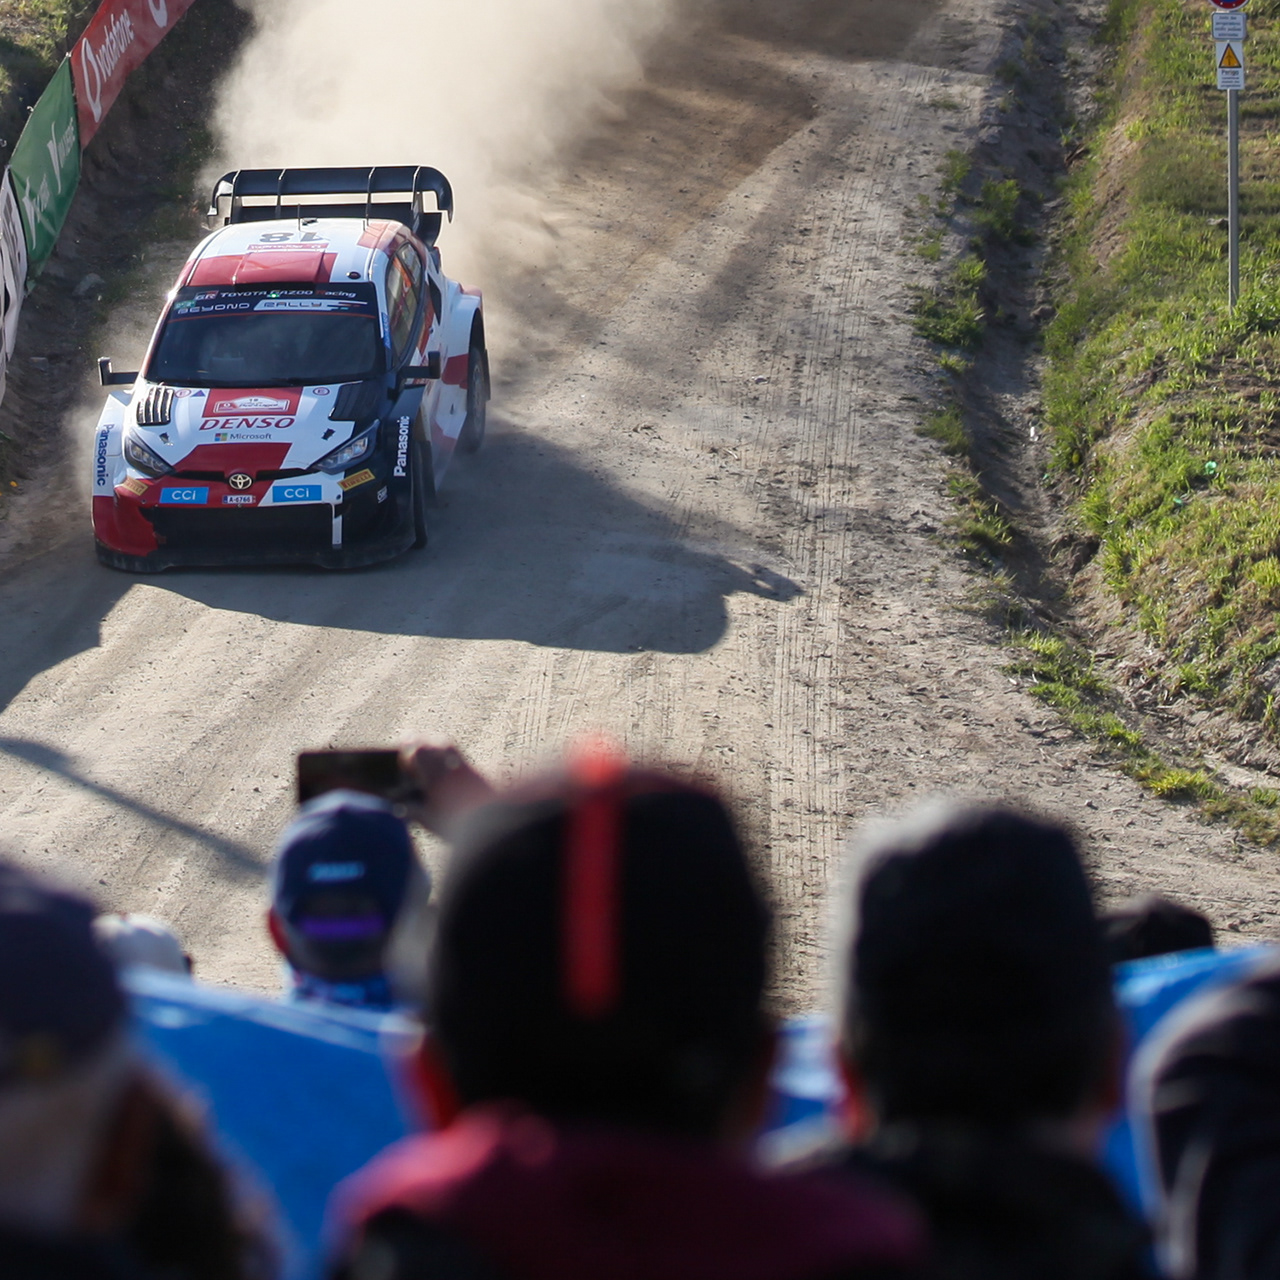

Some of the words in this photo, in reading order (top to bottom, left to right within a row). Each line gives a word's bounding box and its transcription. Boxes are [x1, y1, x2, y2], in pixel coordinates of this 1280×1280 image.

[96, 7, 135, 84] vodafone
[178, 302, 250, 314] BEYOND
[199, 417, 295, 431] DENSO
[230, 432, 272, 440] Microsoft
[97, 423, 115, 487] Panasonic
[393, 415, 410, 477] Panasonic
